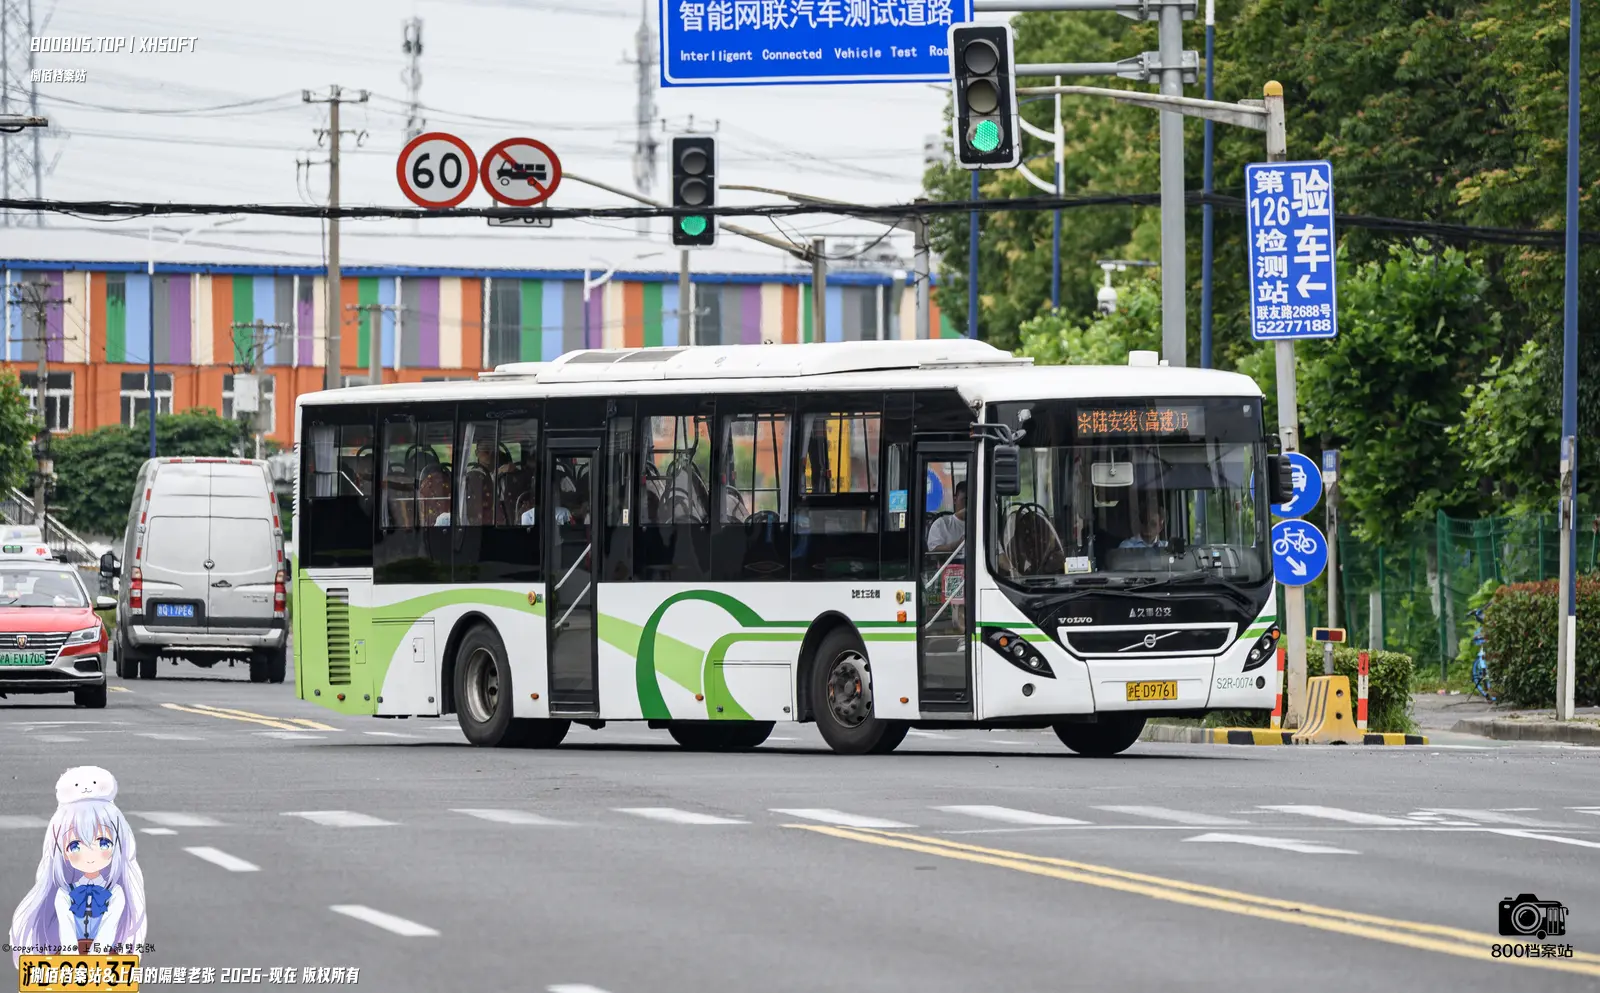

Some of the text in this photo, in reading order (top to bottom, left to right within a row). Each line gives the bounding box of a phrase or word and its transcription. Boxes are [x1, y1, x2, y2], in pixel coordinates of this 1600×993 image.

[679, 0, 953, 32] 智能网联汽车测试道路
[762, 48, 822, 60] Connected
[834, 47, 882, 59] Vehicle
[890, 46, 917, 58] Test
[929, 45, 949, 57] Roa
[412, 152, 462, 189] 60
[1291, 168, 1330, 272] 验车
[1256, 304, 1331, 320] 联友路2688号
[1256, 319, 1331, 334] 52277188
[1216, 678, 1253, 690] S2R-0074
